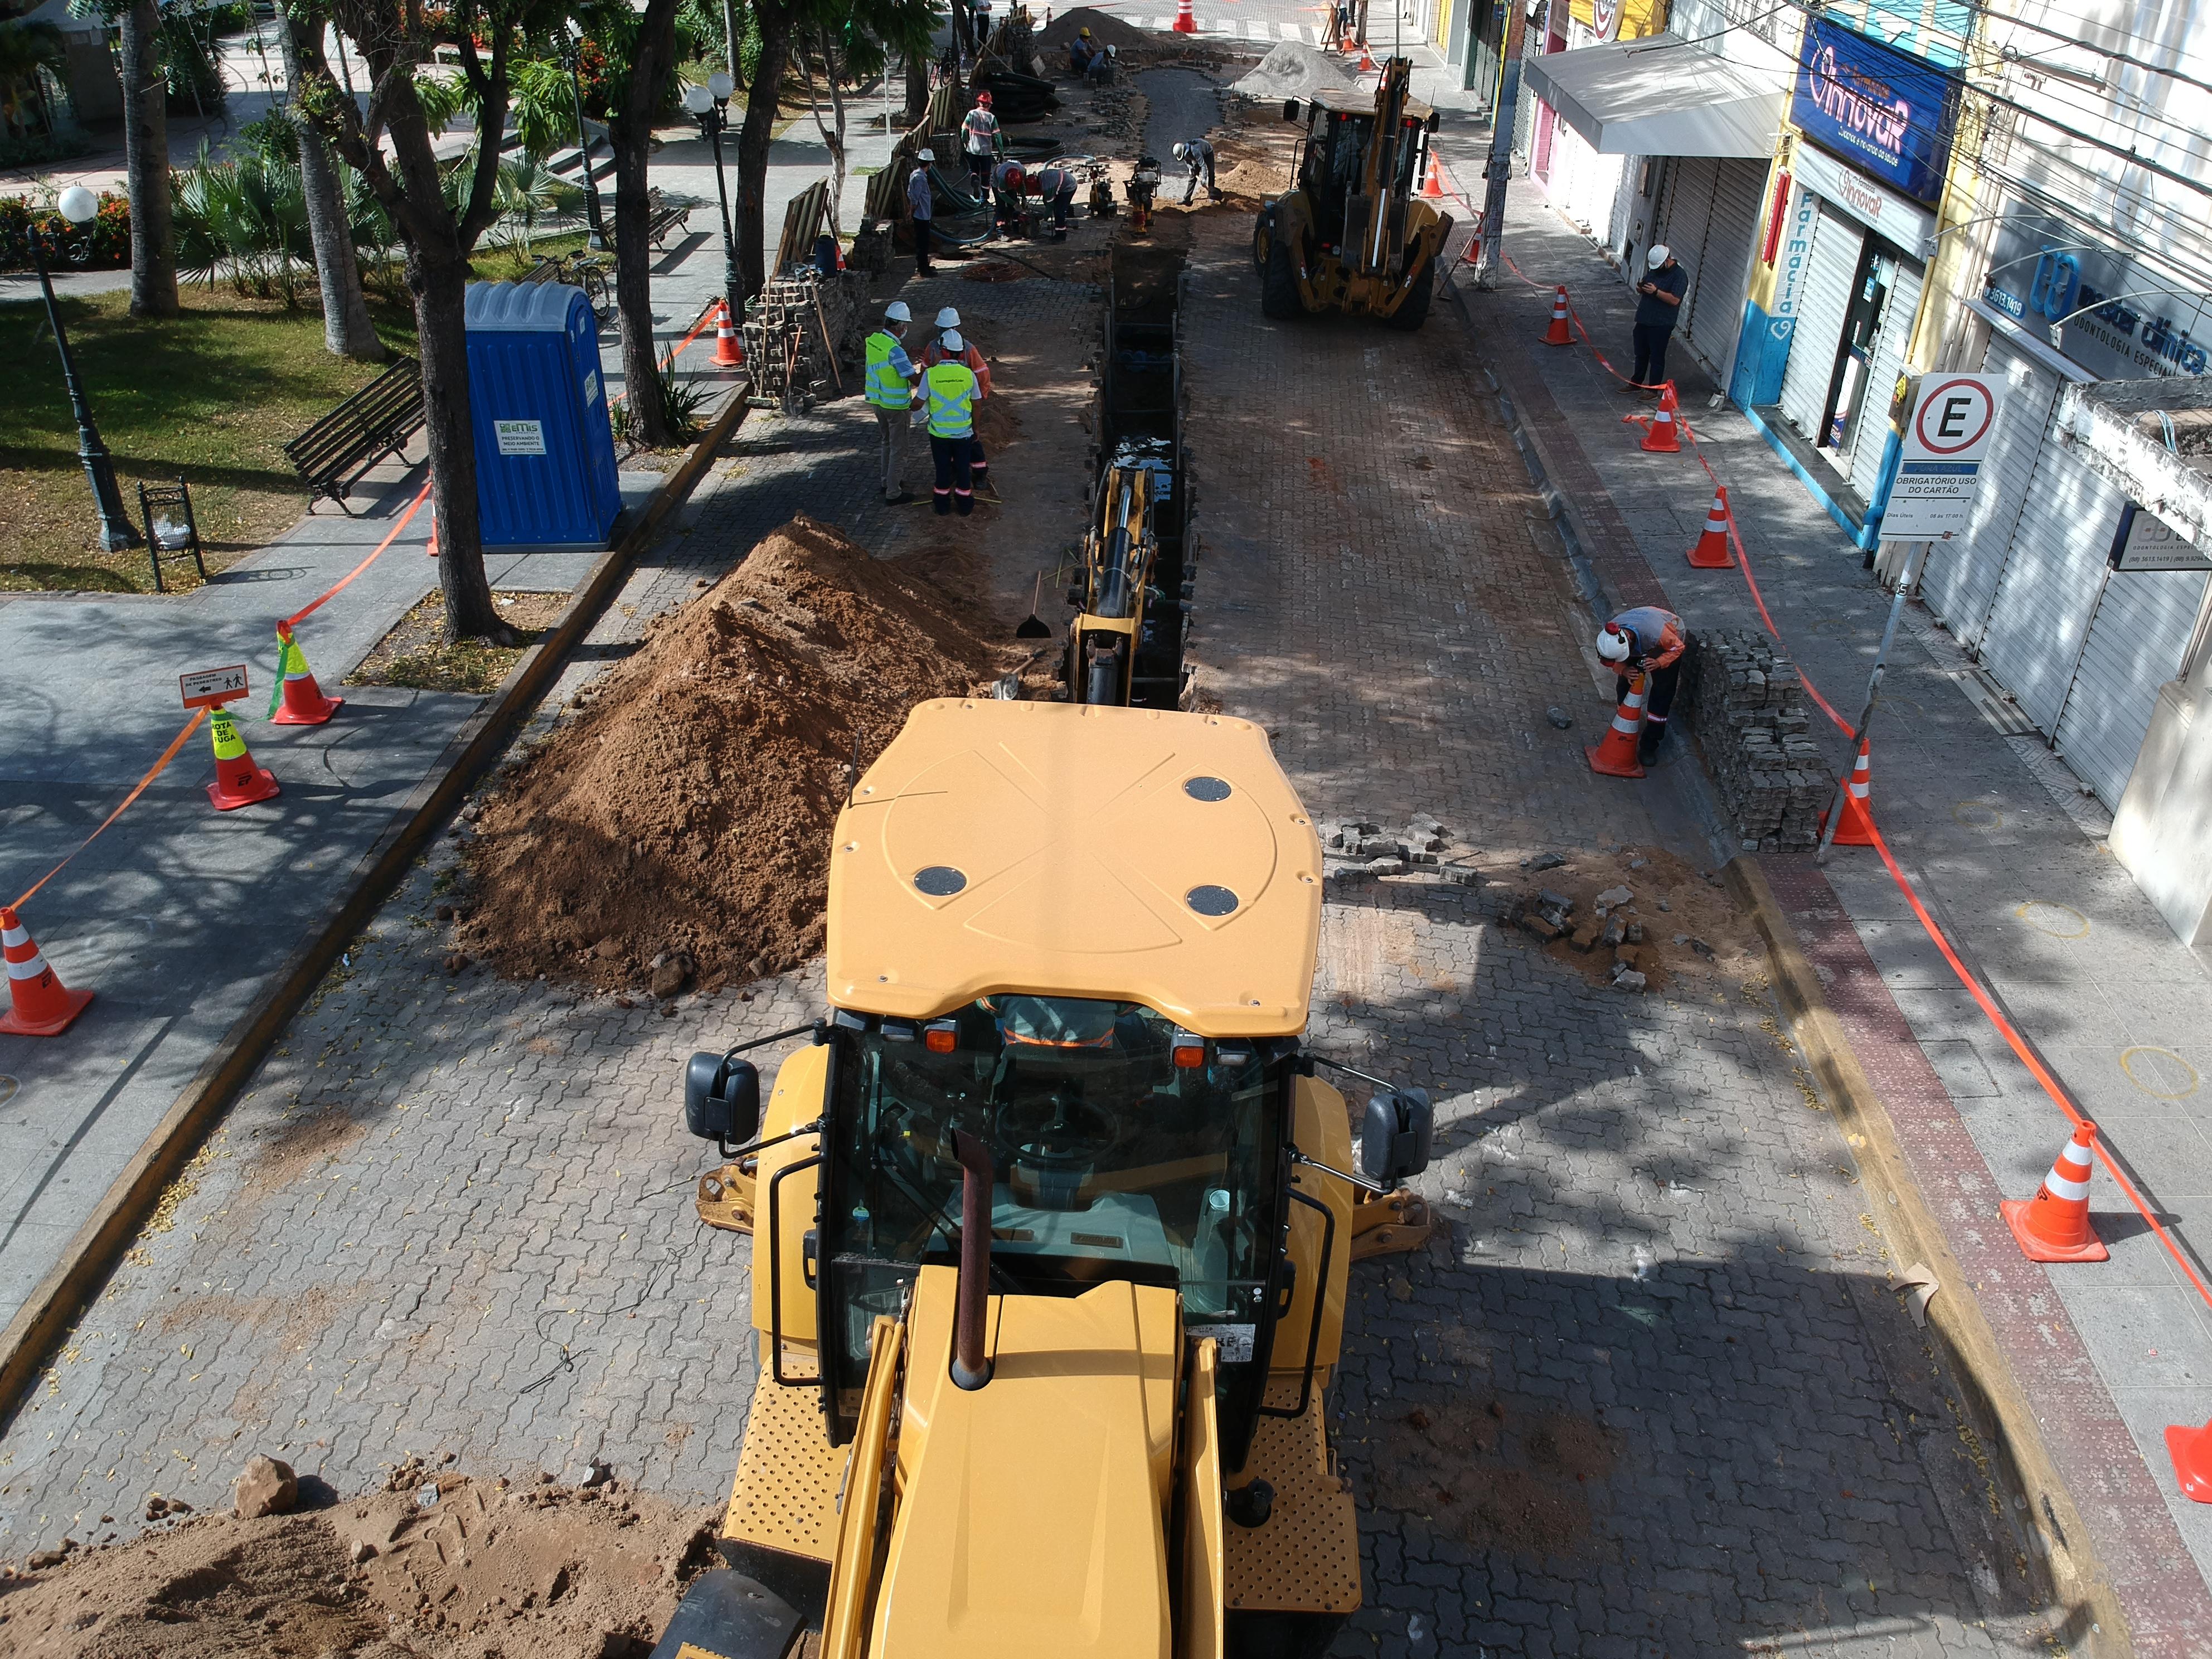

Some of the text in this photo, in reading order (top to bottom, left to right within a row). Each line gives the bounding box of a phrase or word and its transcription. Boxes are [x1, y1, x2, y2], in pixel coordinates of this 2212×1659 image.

[1779, 192, 1815, 314] Farmácia
[1990, 287, 2022, 317] 3613.1419
[2074, 316, 2180, 376] ODONTOLOGIA ESPECIAL
[1937, 398, 1972, 437] E
[1896, 476, 1956, 484] OBRIGATÓRIO
[193, 677, 222, 686] PEDESTRES
[214, 734, 236, 743] FUGA
